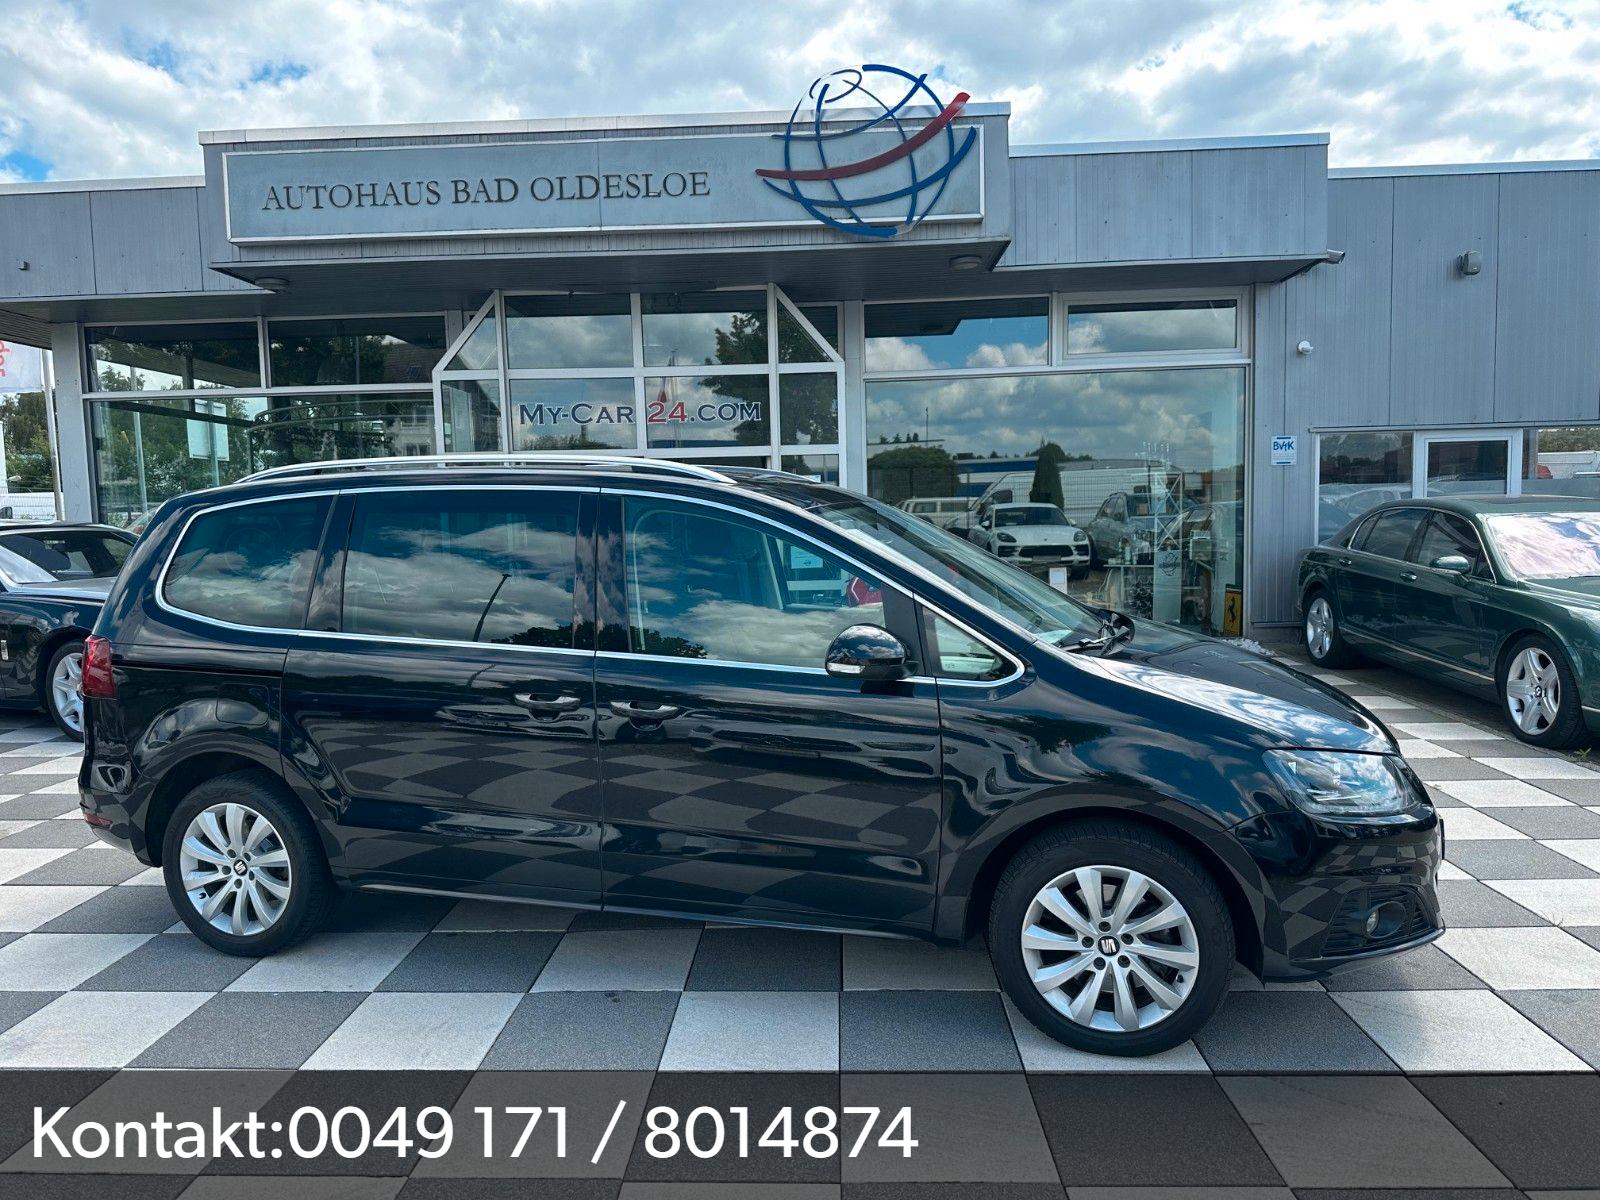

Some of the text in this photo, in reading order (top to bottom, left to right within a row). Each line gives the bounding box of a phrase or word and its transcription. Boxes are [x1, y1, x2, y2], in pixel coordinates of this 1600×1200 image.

[262, 172, 711, 211] AUTOHAUS BAD OLDESLOE
